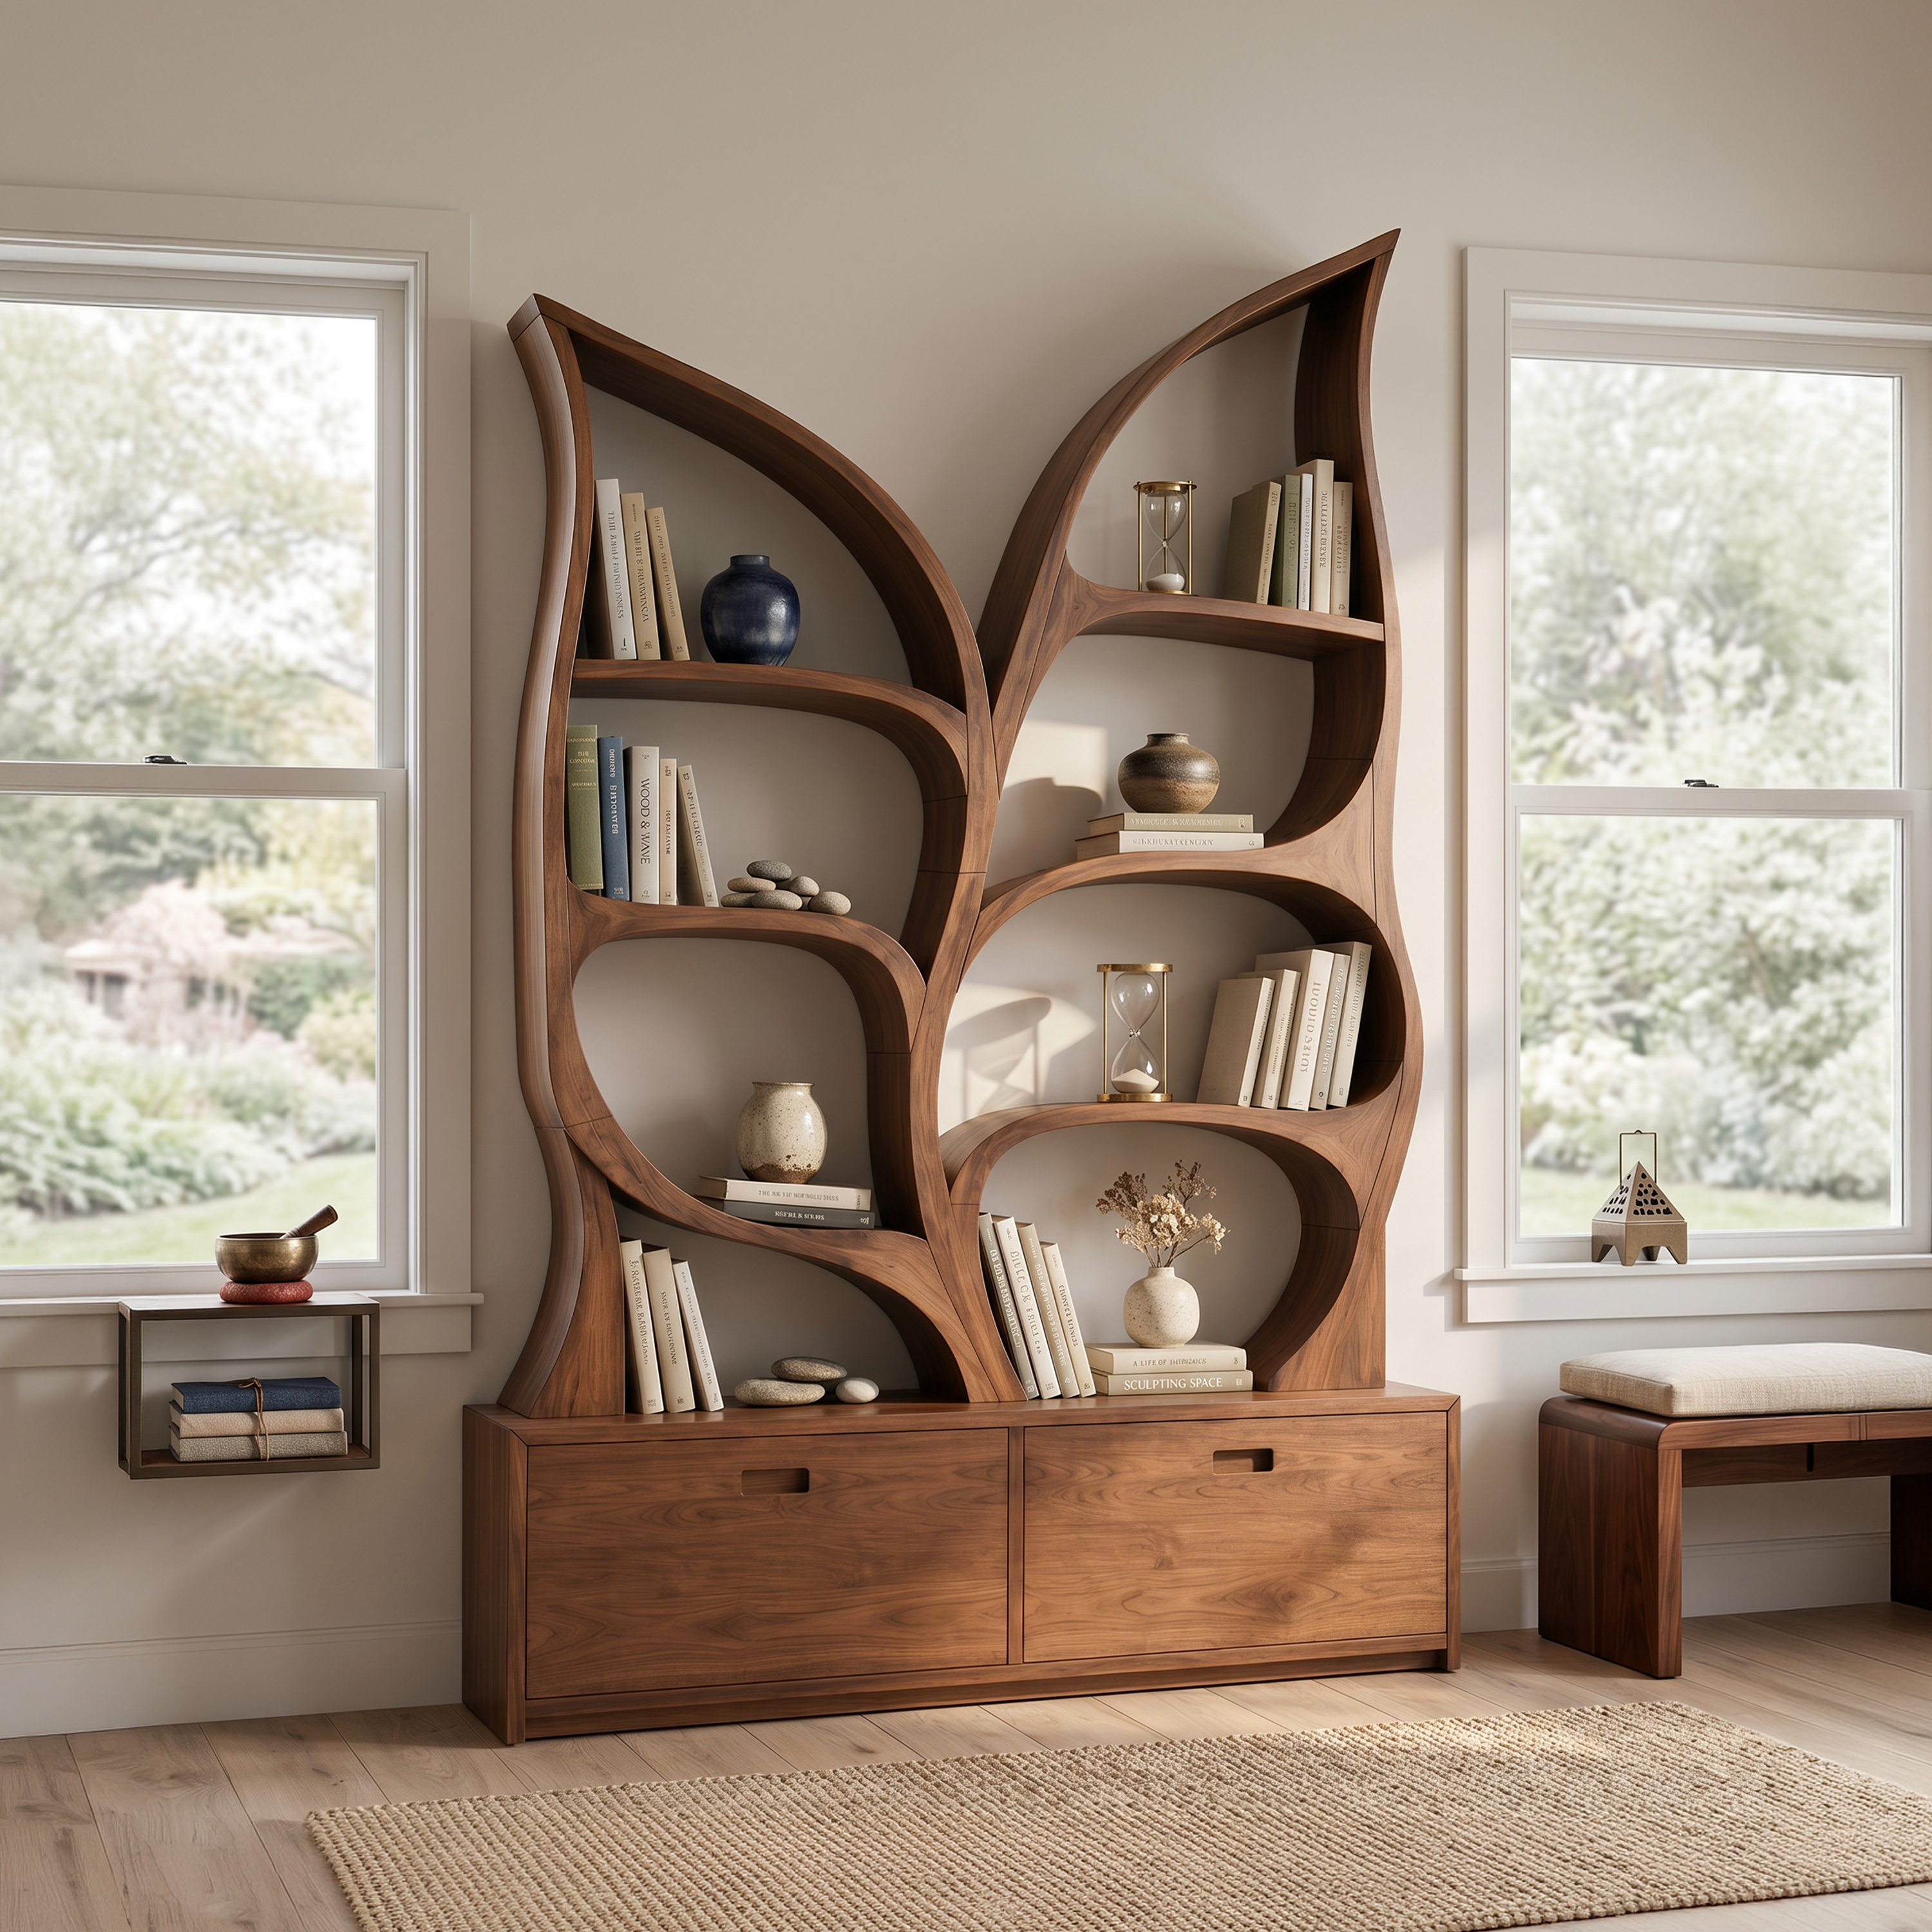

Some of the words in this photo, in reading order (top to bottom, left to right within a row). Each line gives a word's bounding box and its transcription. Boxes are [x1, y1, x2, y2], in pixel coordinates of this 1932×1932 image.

[641, 779, 650, 817] WOOD
[640, 820, 650, 829] &
[641, 832, 650, 864] WAVE
[1124, 1378, 1186, 1390] SCULPTING
[1189, 1378, 1222, 1388] SPACE
